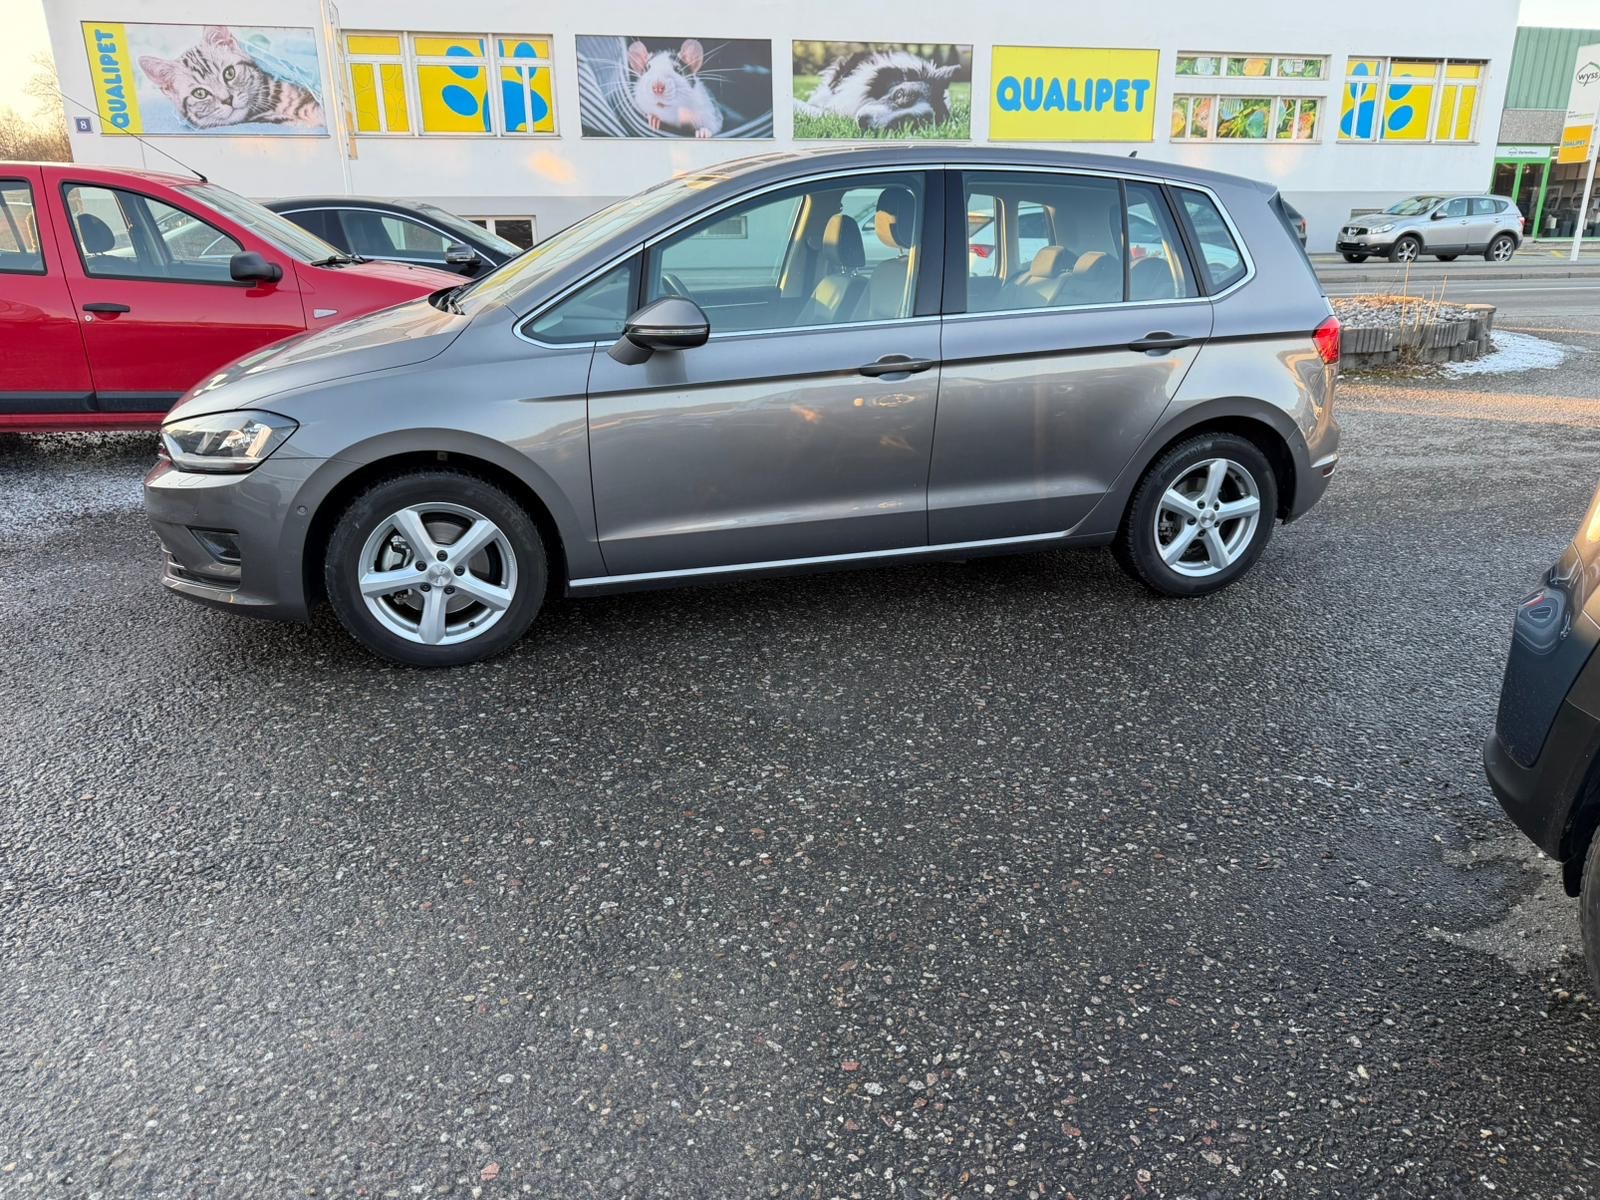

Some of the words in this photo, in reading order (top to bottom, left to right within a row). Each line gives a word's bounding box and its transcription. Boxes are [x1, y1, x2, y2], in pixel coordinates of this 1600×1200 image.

[94, 29, 130, 128] QUALIPET
[1578, 72, 1599, 87] wyss
[996, 75, 1151, 112] QUALIPET
[80, 120, 87, 129] 8
